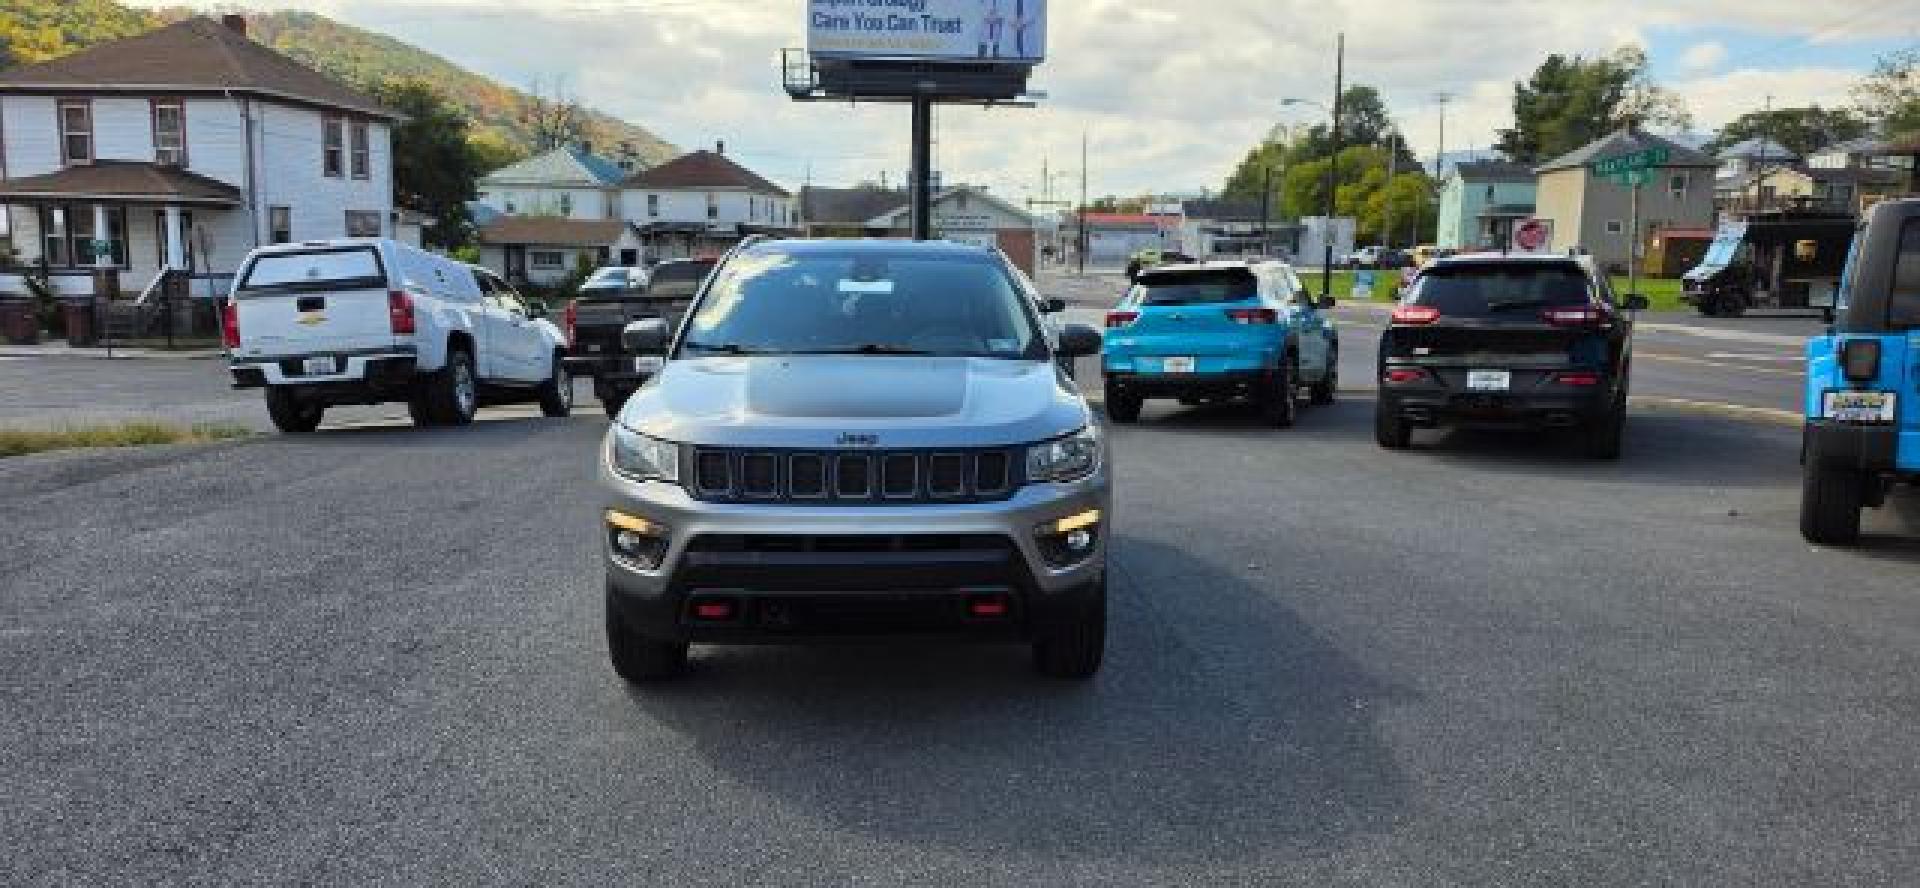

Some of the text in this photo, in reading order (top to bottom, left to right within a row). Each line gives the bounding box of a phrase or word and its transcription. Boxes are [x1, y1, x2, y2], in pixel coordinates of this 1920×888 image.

[812, 12, 961, 33] Care You Can Trust
